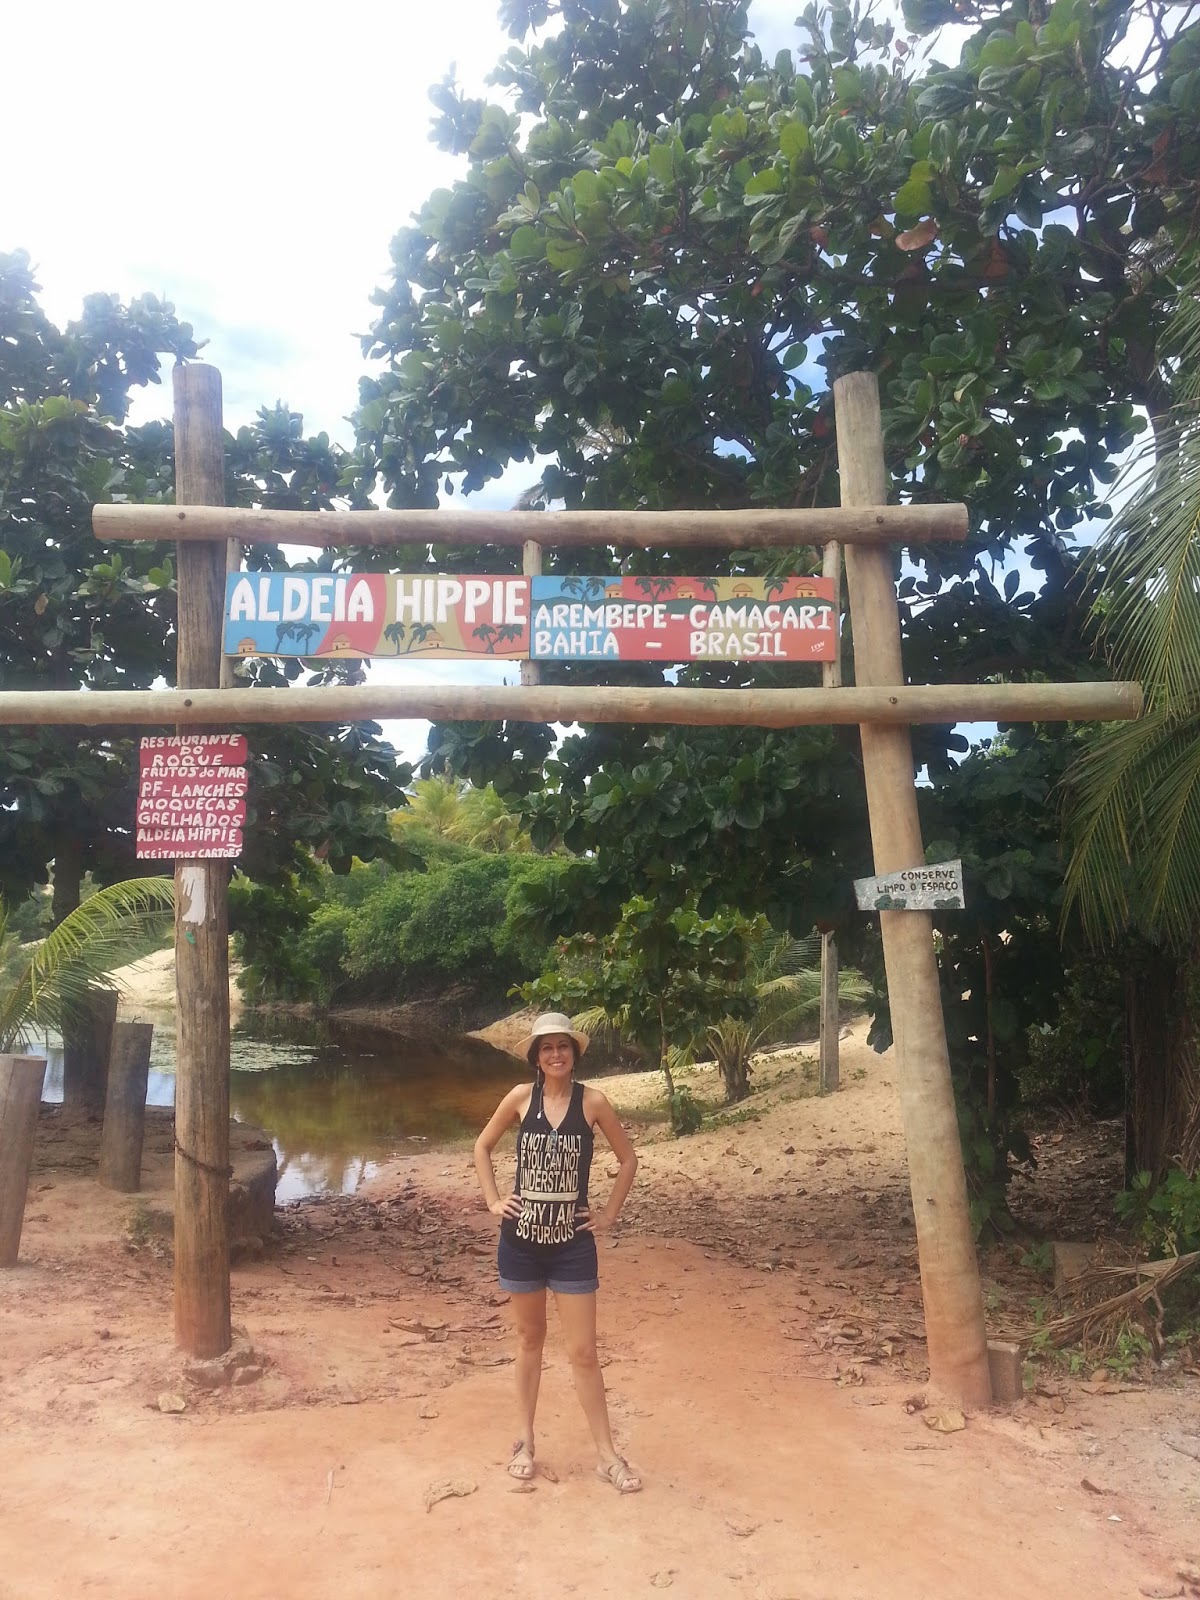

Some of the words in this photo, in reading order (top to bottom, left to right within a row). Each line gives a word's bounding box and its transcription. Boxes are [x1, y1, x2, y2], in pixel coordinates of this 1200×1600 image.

[230, 577, 374, 622] ALDEIA
[396, 579, 527, 624] HIPPIE
[534, 631, 620, 656] BAHIA
[690, 631, 787, 657] BRASIL
[140, 734, 242, 749] RESTAURANTE
[180, 746, 204, 756] DO
[152, 754, 223, 767] ROQUE
[141, 767, 199, 778] FRUTOS
[217, 767, 247, 779] MAR
[140, 798, 239, 811] MOQUECAS
[138, 812, 243, 827] GRELHADOS
[137, 828, 185, 842] ALDEIA
[901, 870, 955, 880] CONSERVE
[877, 884, 905, 893] LIMPO
[921, 882, 958, 892] ESPAÇO
[527, 1133, 546, 1151] NOT
[558, 1135, 581, 1152] FAULT
[527, 1151, 543, 1169] YOU
[544, 1153, 562, 1170] CAN
[563, 1153, 580, 1170] NOT
[520, 1168, 579, 1192] UNDERSTAND
[520, 1200, 546, 1224] WHY
[549, 1203, 554, 1226] I
[555, 1203, 576, 1226] AM
[516, 1219, 529, 1239] SO
[531, 1224, 574, 1244] FURIOUS
